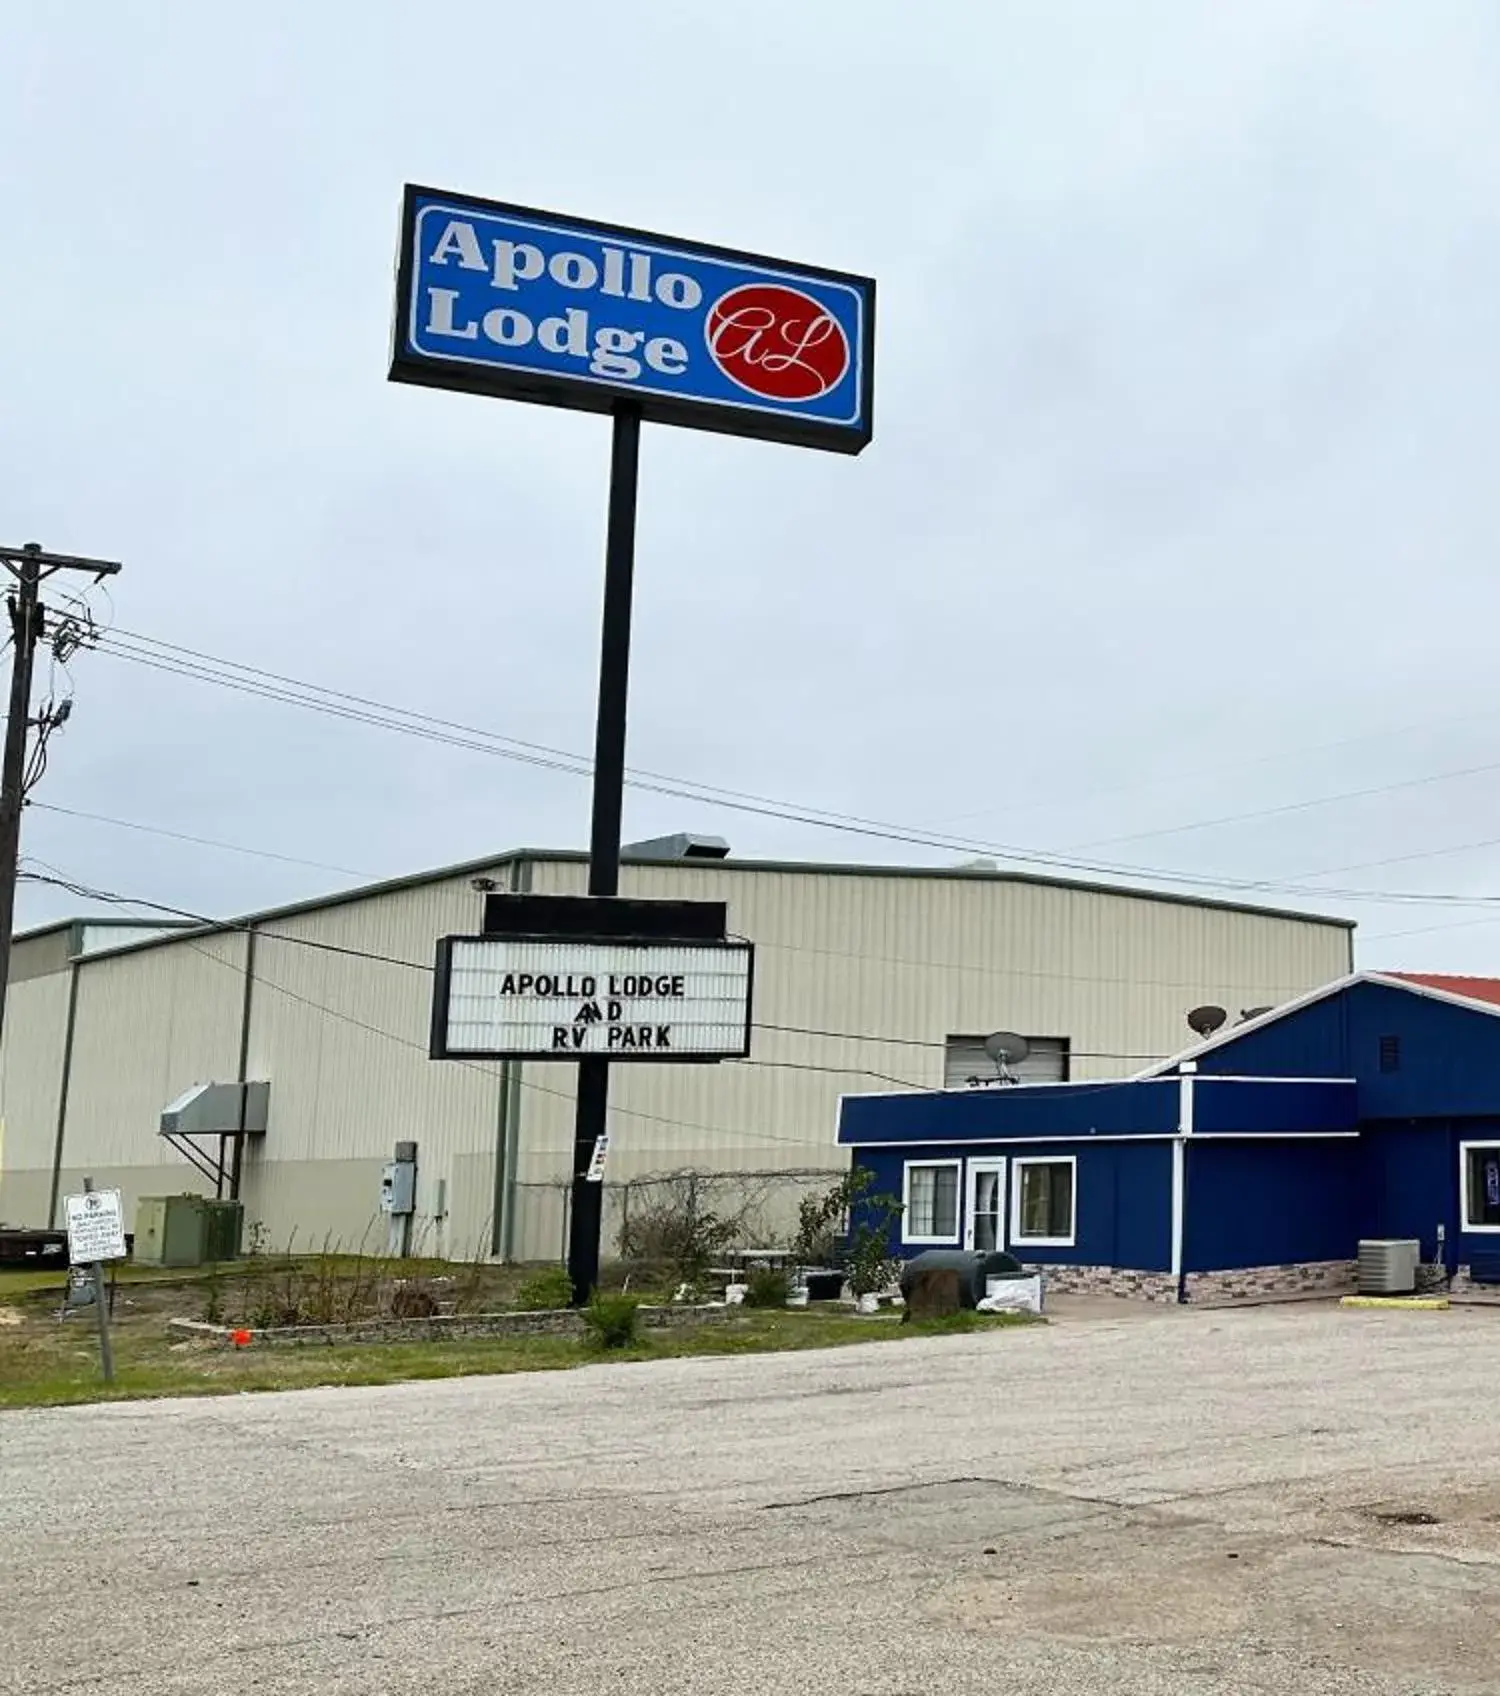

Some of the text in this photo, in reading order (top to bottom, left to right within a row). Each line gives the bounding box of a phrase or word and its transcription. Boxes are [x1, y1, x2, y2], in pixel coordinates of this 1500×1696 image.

[428, 220, 703, 310] Apollo
[425, 287, 689, 380] Lodge
[710, 305, 835, 395] AL
[500, 974, 685, 998] APOLLO LODGE
[574, 1001, 622, 1024] AND
[553, 1024, 672, 1049] RV PARK
